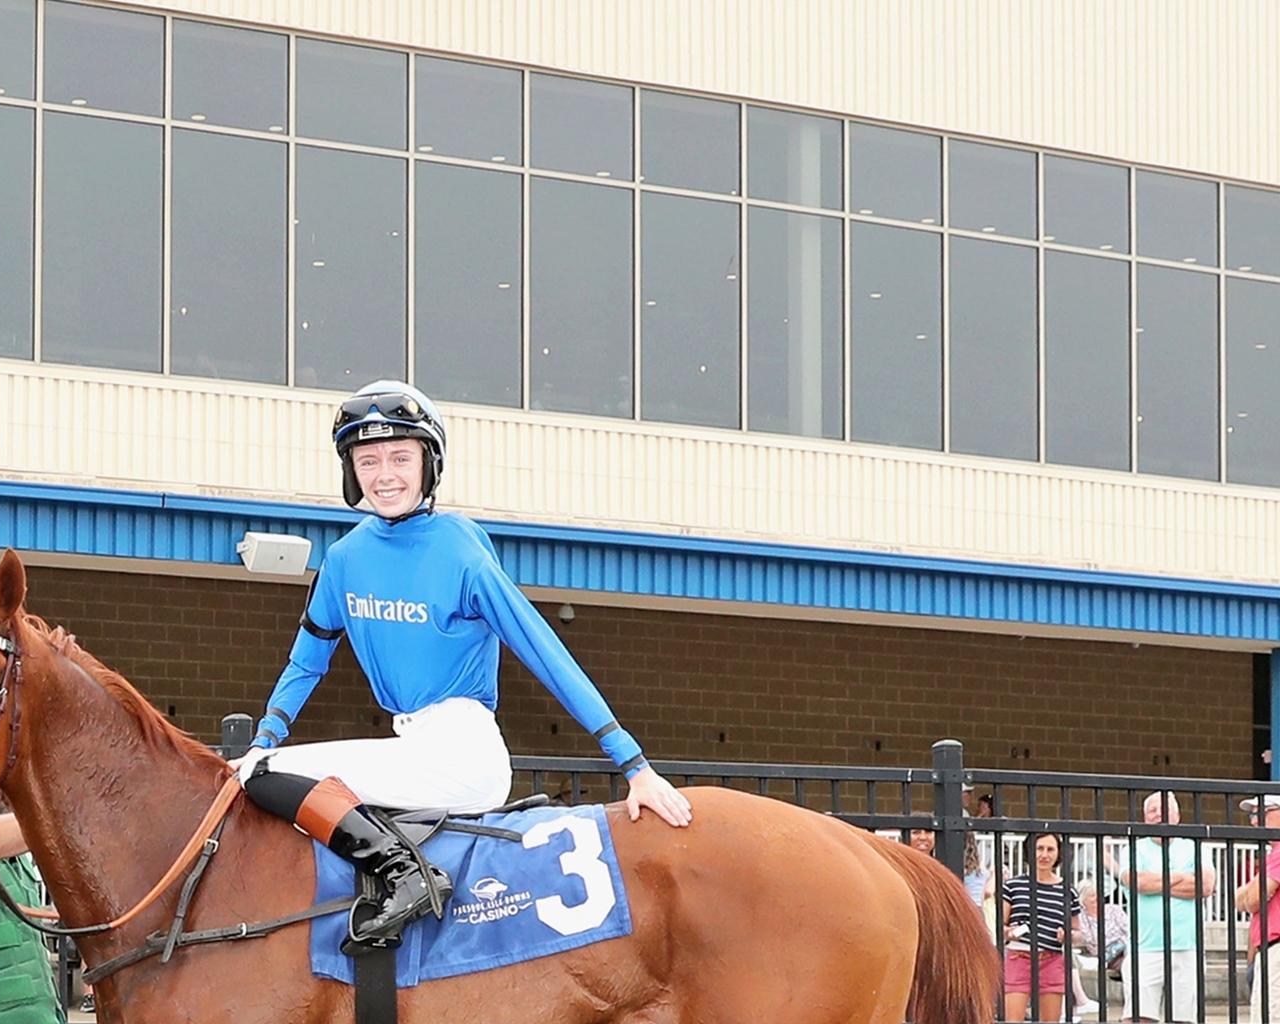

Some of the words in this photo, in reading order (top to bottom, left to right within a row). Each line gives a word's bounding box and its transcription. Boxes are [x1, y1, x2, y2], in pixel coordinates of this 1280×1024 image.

[345, 592, 429, 624] Emirates
[522, 815, 616, 937] 3
[469, 904, 519, 925] CASINO
